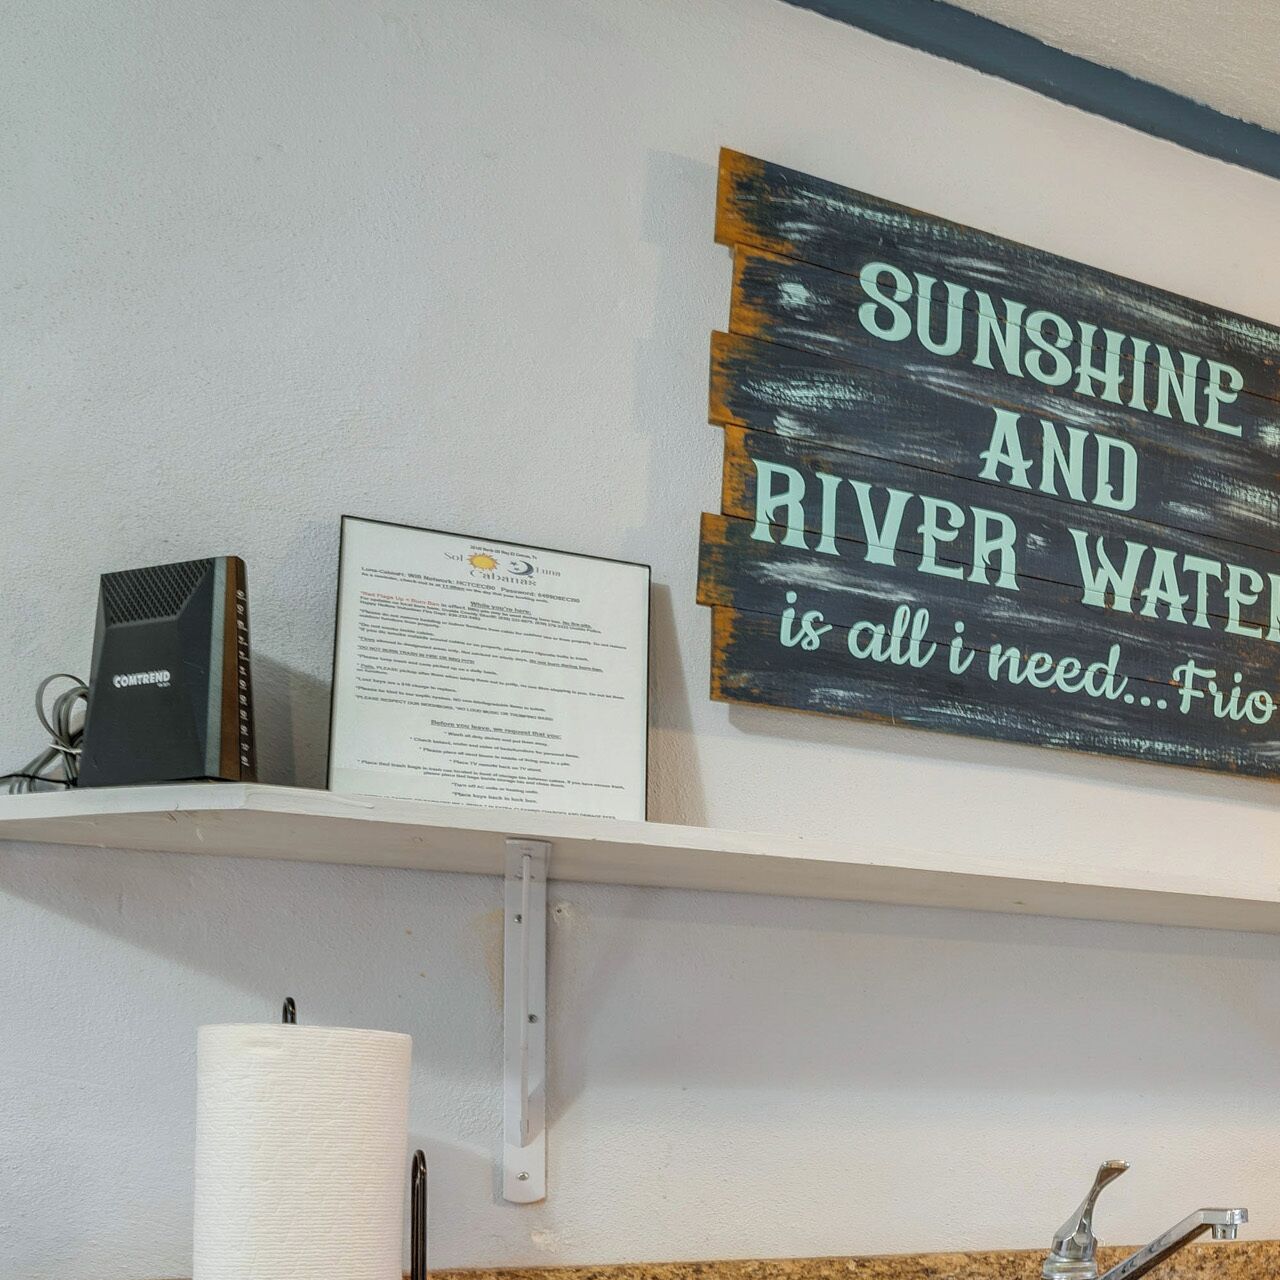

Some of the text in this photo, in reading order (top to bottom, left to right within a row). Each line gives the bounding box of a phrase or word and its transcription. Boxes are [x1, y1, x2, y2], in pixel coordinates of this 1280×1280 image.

[858, 262, 1244, 436] SUNSHINE
[978, 408, 1137, 512] AND
[444, 553, 463, 561] Sol
[750, 458, 1020, 591] RIVER
[470, 570, 536, 586] Cabanas
[778, 591, 832, 651] is
[848, 604, 936, 669] all
[948, 622, 974, 674] i
[113, 670, 171, 688] COMTREND
